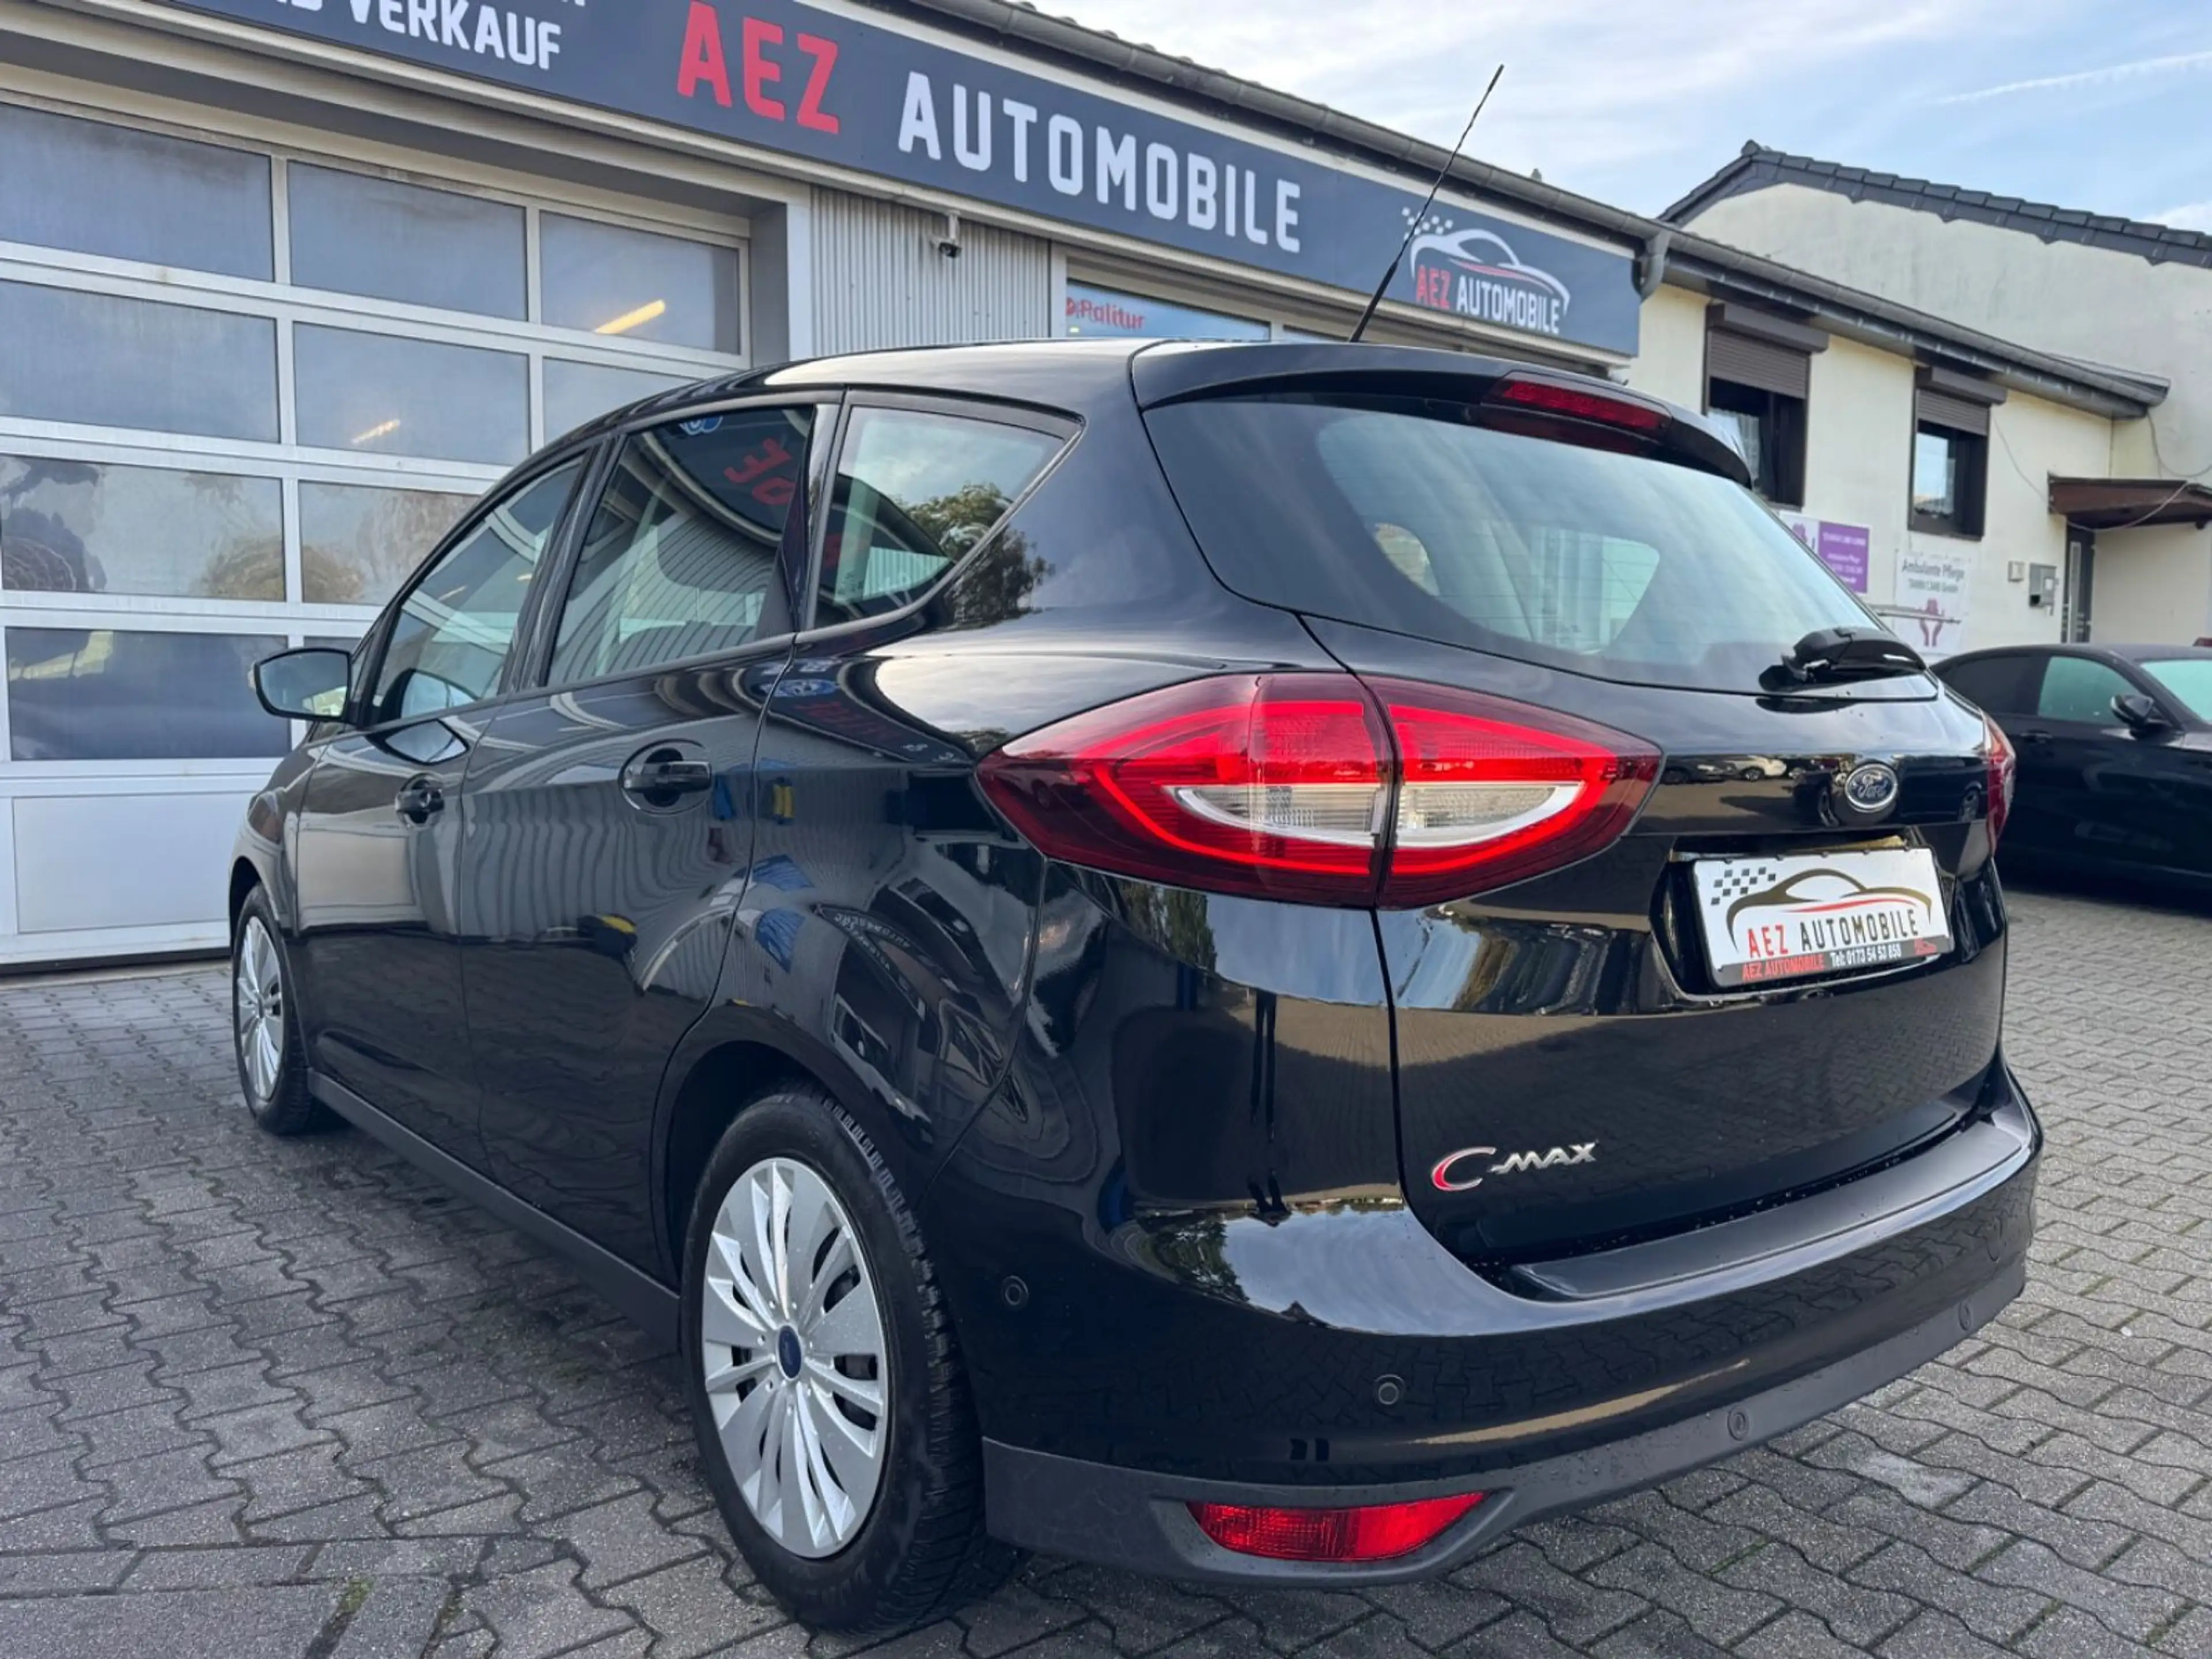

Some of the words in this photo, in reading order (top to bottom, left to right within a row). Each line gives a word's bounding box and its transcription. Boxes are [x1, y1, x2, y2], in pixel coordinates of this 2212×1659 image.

[677, 1, 839, 135] AEZ
[898, 70, 1301, 253] AUTOMOBILE
[1416, 264, 1451, 309] AEZ
[1456, 274, 1560, 335] AUTOMOBILE
[1747, 923, 1789, 959] AEZ
[1800, 908, 1919, 952] AUTOMOBILE
[1742, 963, 1763, 980] AEZ
[1764, 954, 1825, 976] AUTOMOBILE
